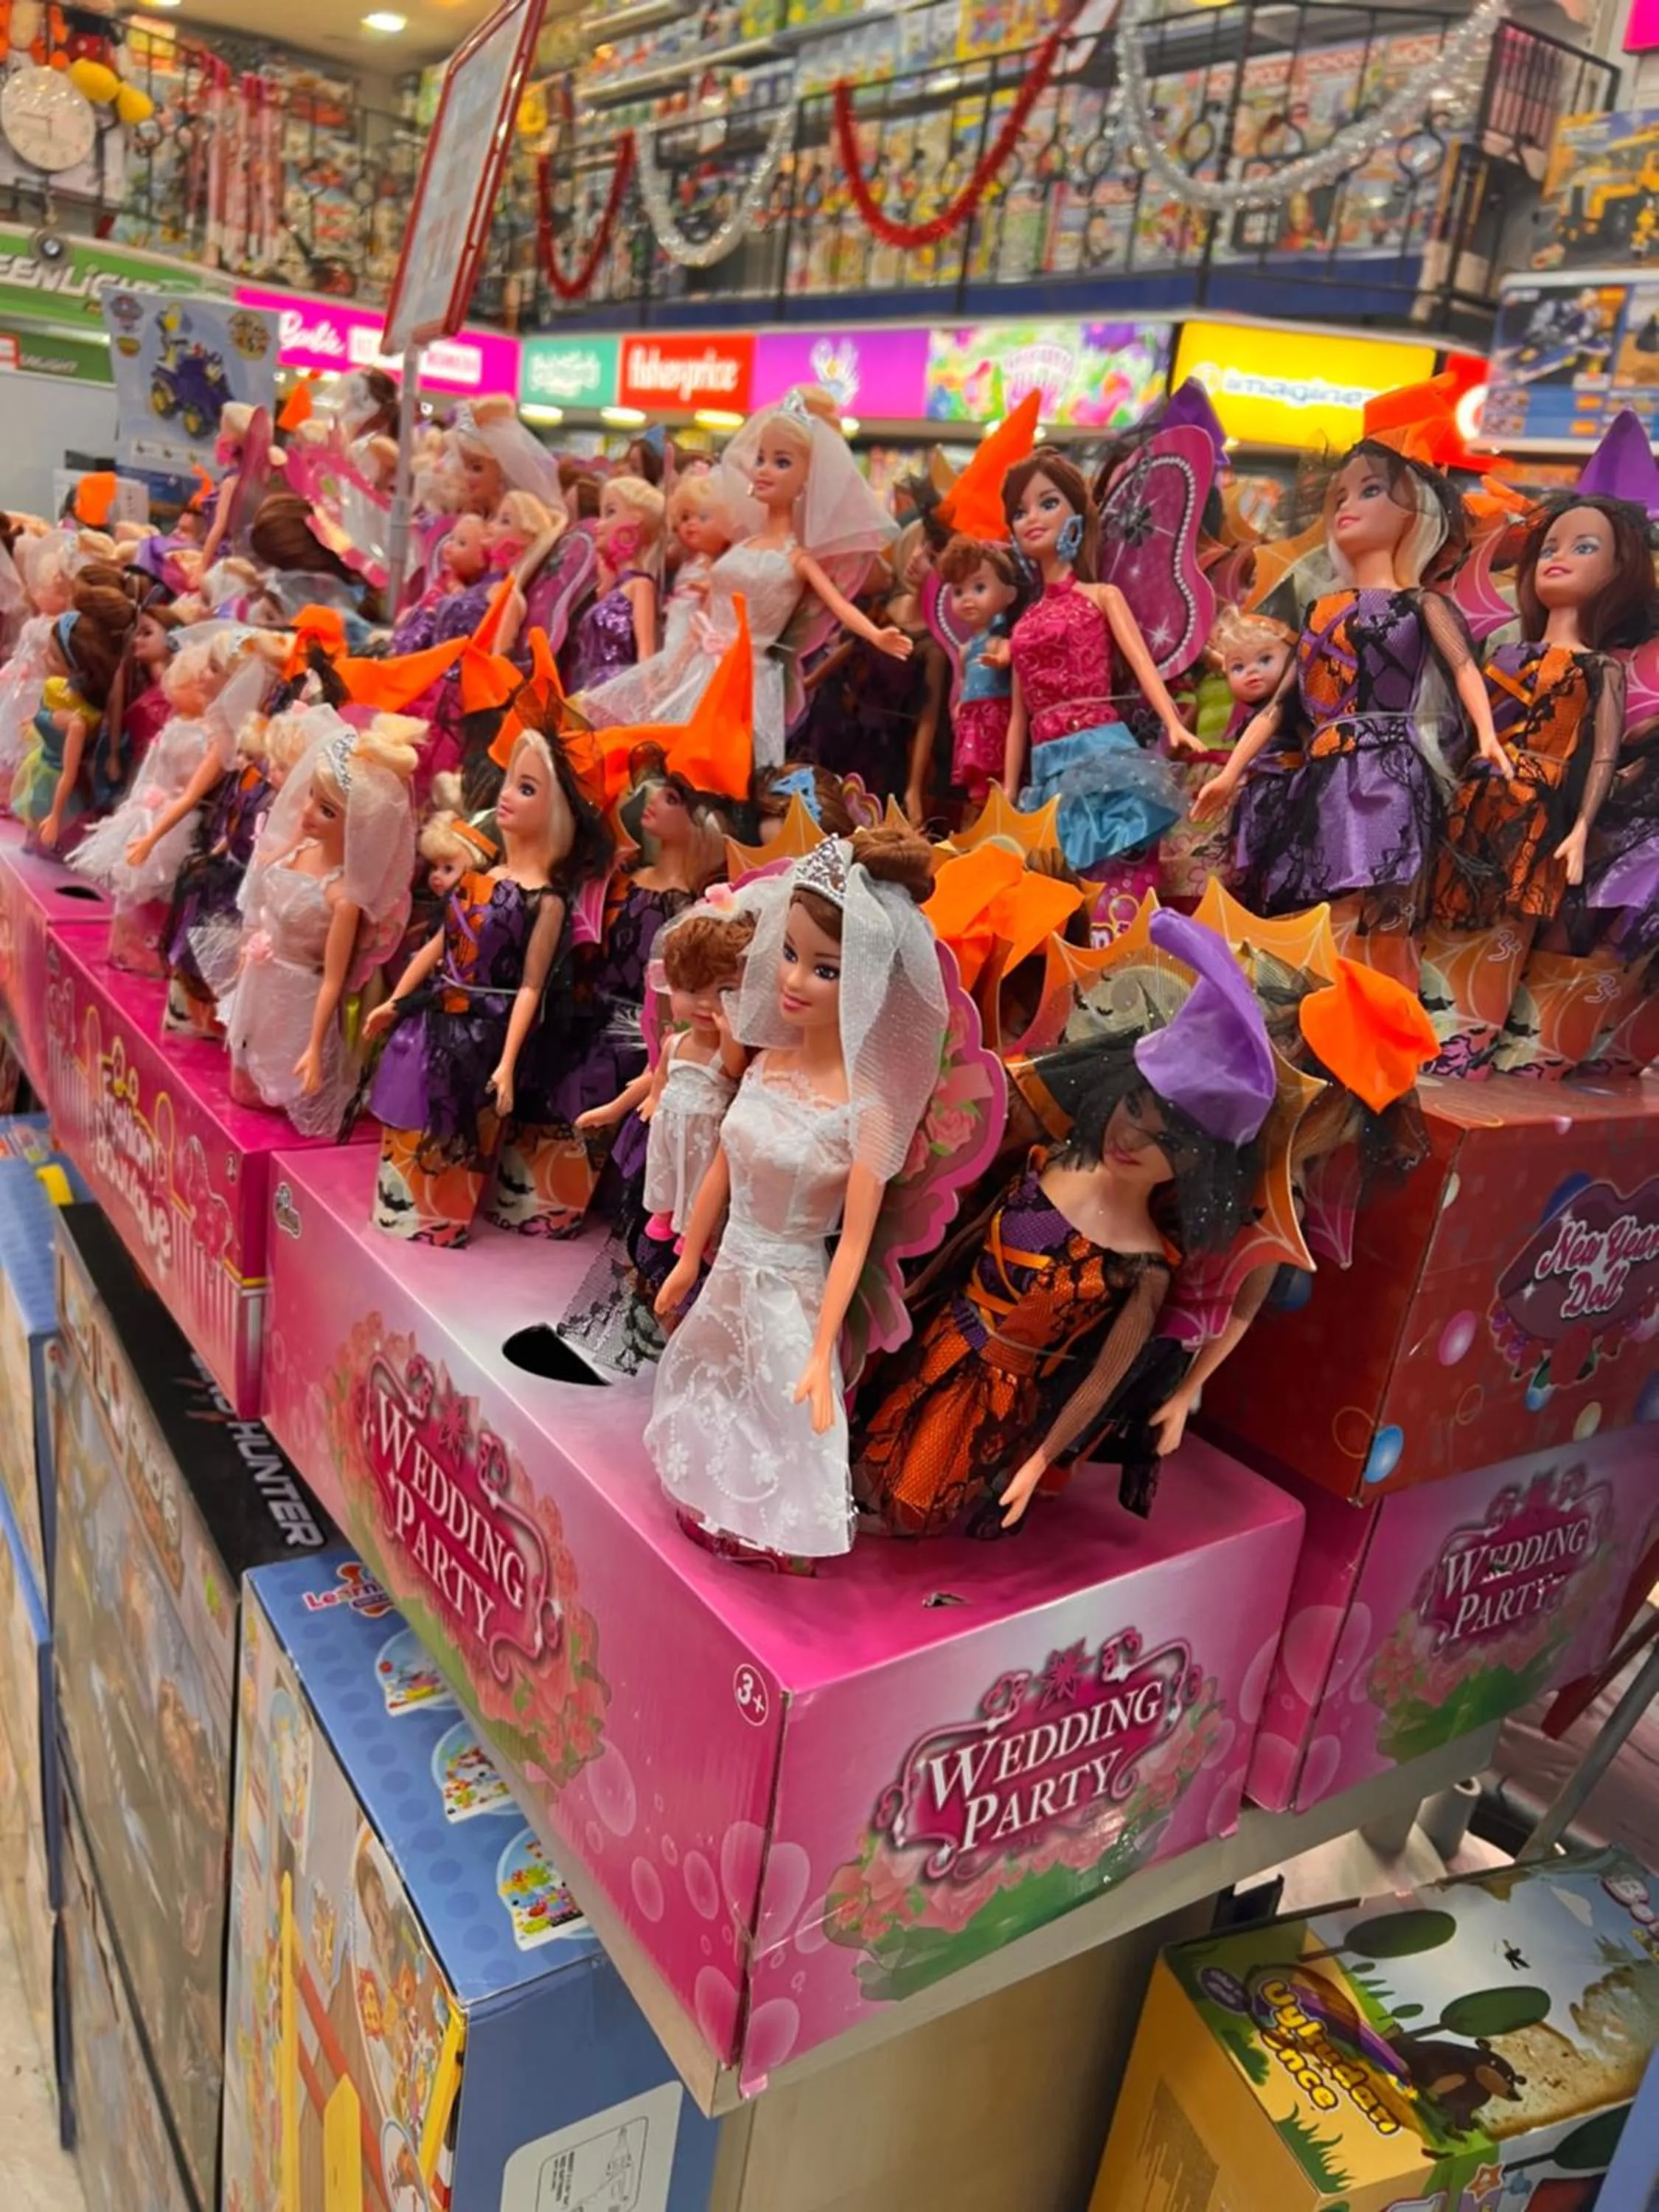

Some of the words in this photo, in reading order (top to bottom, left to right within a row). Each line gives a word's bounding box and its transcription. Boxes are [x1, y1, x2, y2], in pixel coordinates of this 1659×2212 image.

[1534, 1220, 1608, 1279] New
[1560, 1261, 1630, 1318] Doll
[226, 1421, 325, 1547] HUNTER
[379, 1389, 525, 1610] WEDDING
[388, 1473, 495, 1644] PARTY
[1441, 1519, 1589, 1601] WEDDING
[1450, 1574, 1565, 1641] PARTY
[737, 1672, 765, 1713] 3+
[929, 1681, 1163, 1811] WEDDING
[958, 1748, 1124, 1854] PARTY
